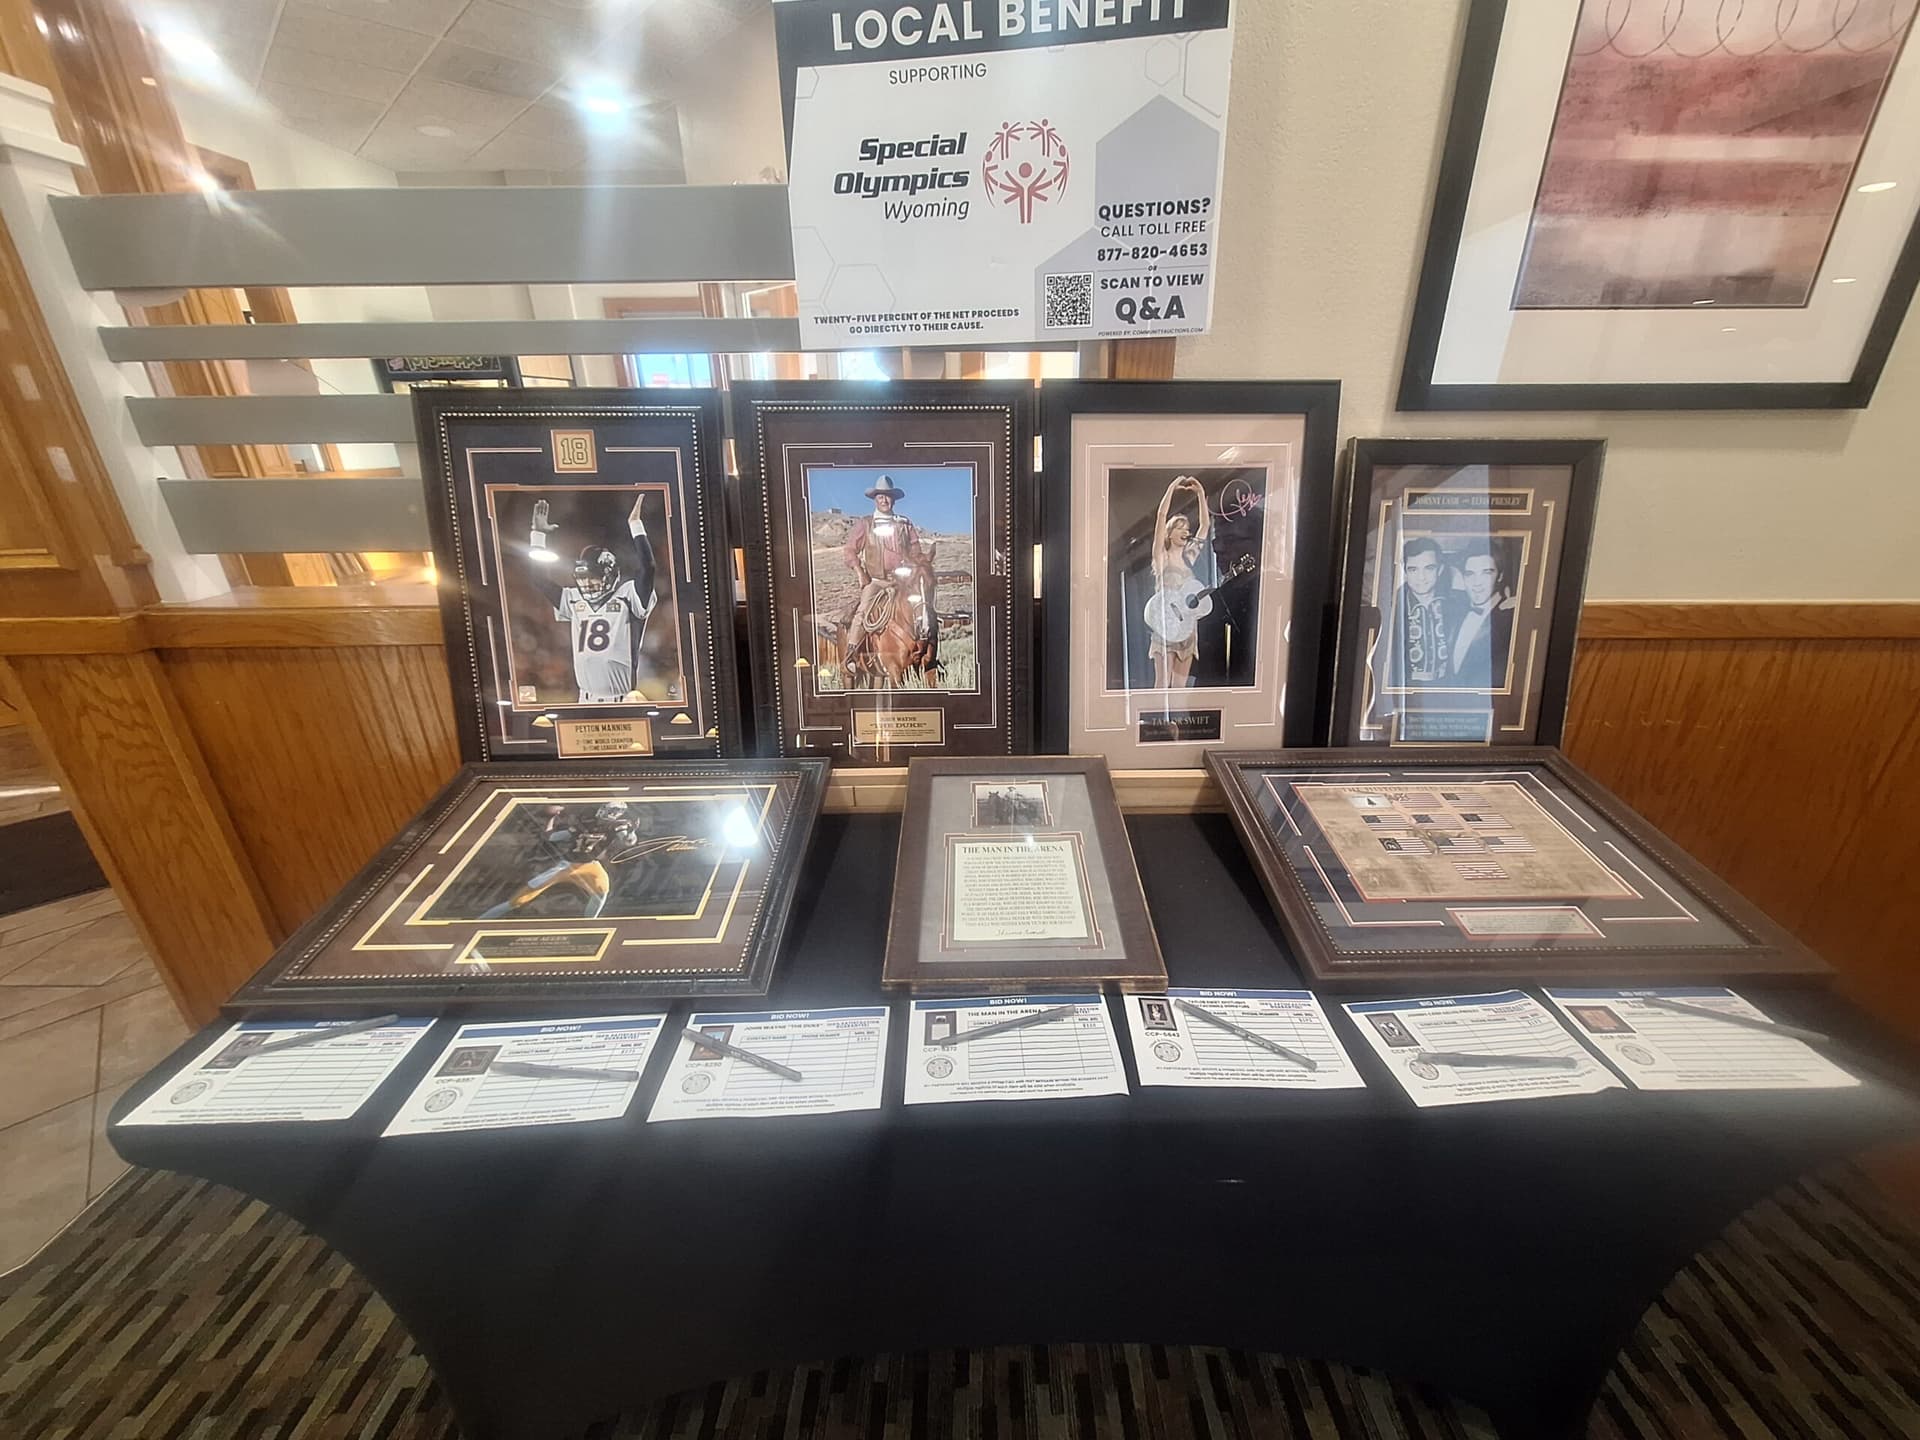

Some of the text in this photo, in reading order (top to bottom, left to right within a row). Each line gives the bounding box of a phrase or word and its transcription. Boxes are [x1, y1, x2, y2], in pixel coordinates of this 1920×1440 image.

[832, 0, 983, 51] LOCAL
[889, 62, 987, 85] SUPPORTING
[859, 132, 967, 165] Special
[834, 168, 969, 198] Olympics
[885, 197, 969, 223] Wyoming
[1098, 198, 1210, 221] QUESTIONS?
[1101, 220, 1207, 237] CALL TOLL FREE
[1097, 243, 1208, 261] 877-820-4653
[1100, 273, 1204, 289] SCAN TO VIEW
[814, 308, 1019, 324] TWENTY-FIVE PERCENT OF THE NET PROCEEDS
[1115, 295, 1185, 324] Q&A
[849, 321, 983, 334] GO DIRECTLY TO THEIR CAUSE.
[561, 437, 588, 464] 18
[578, 619, 610, 652] 18
[576, 723, 632, 733] PEYTON MANNING
